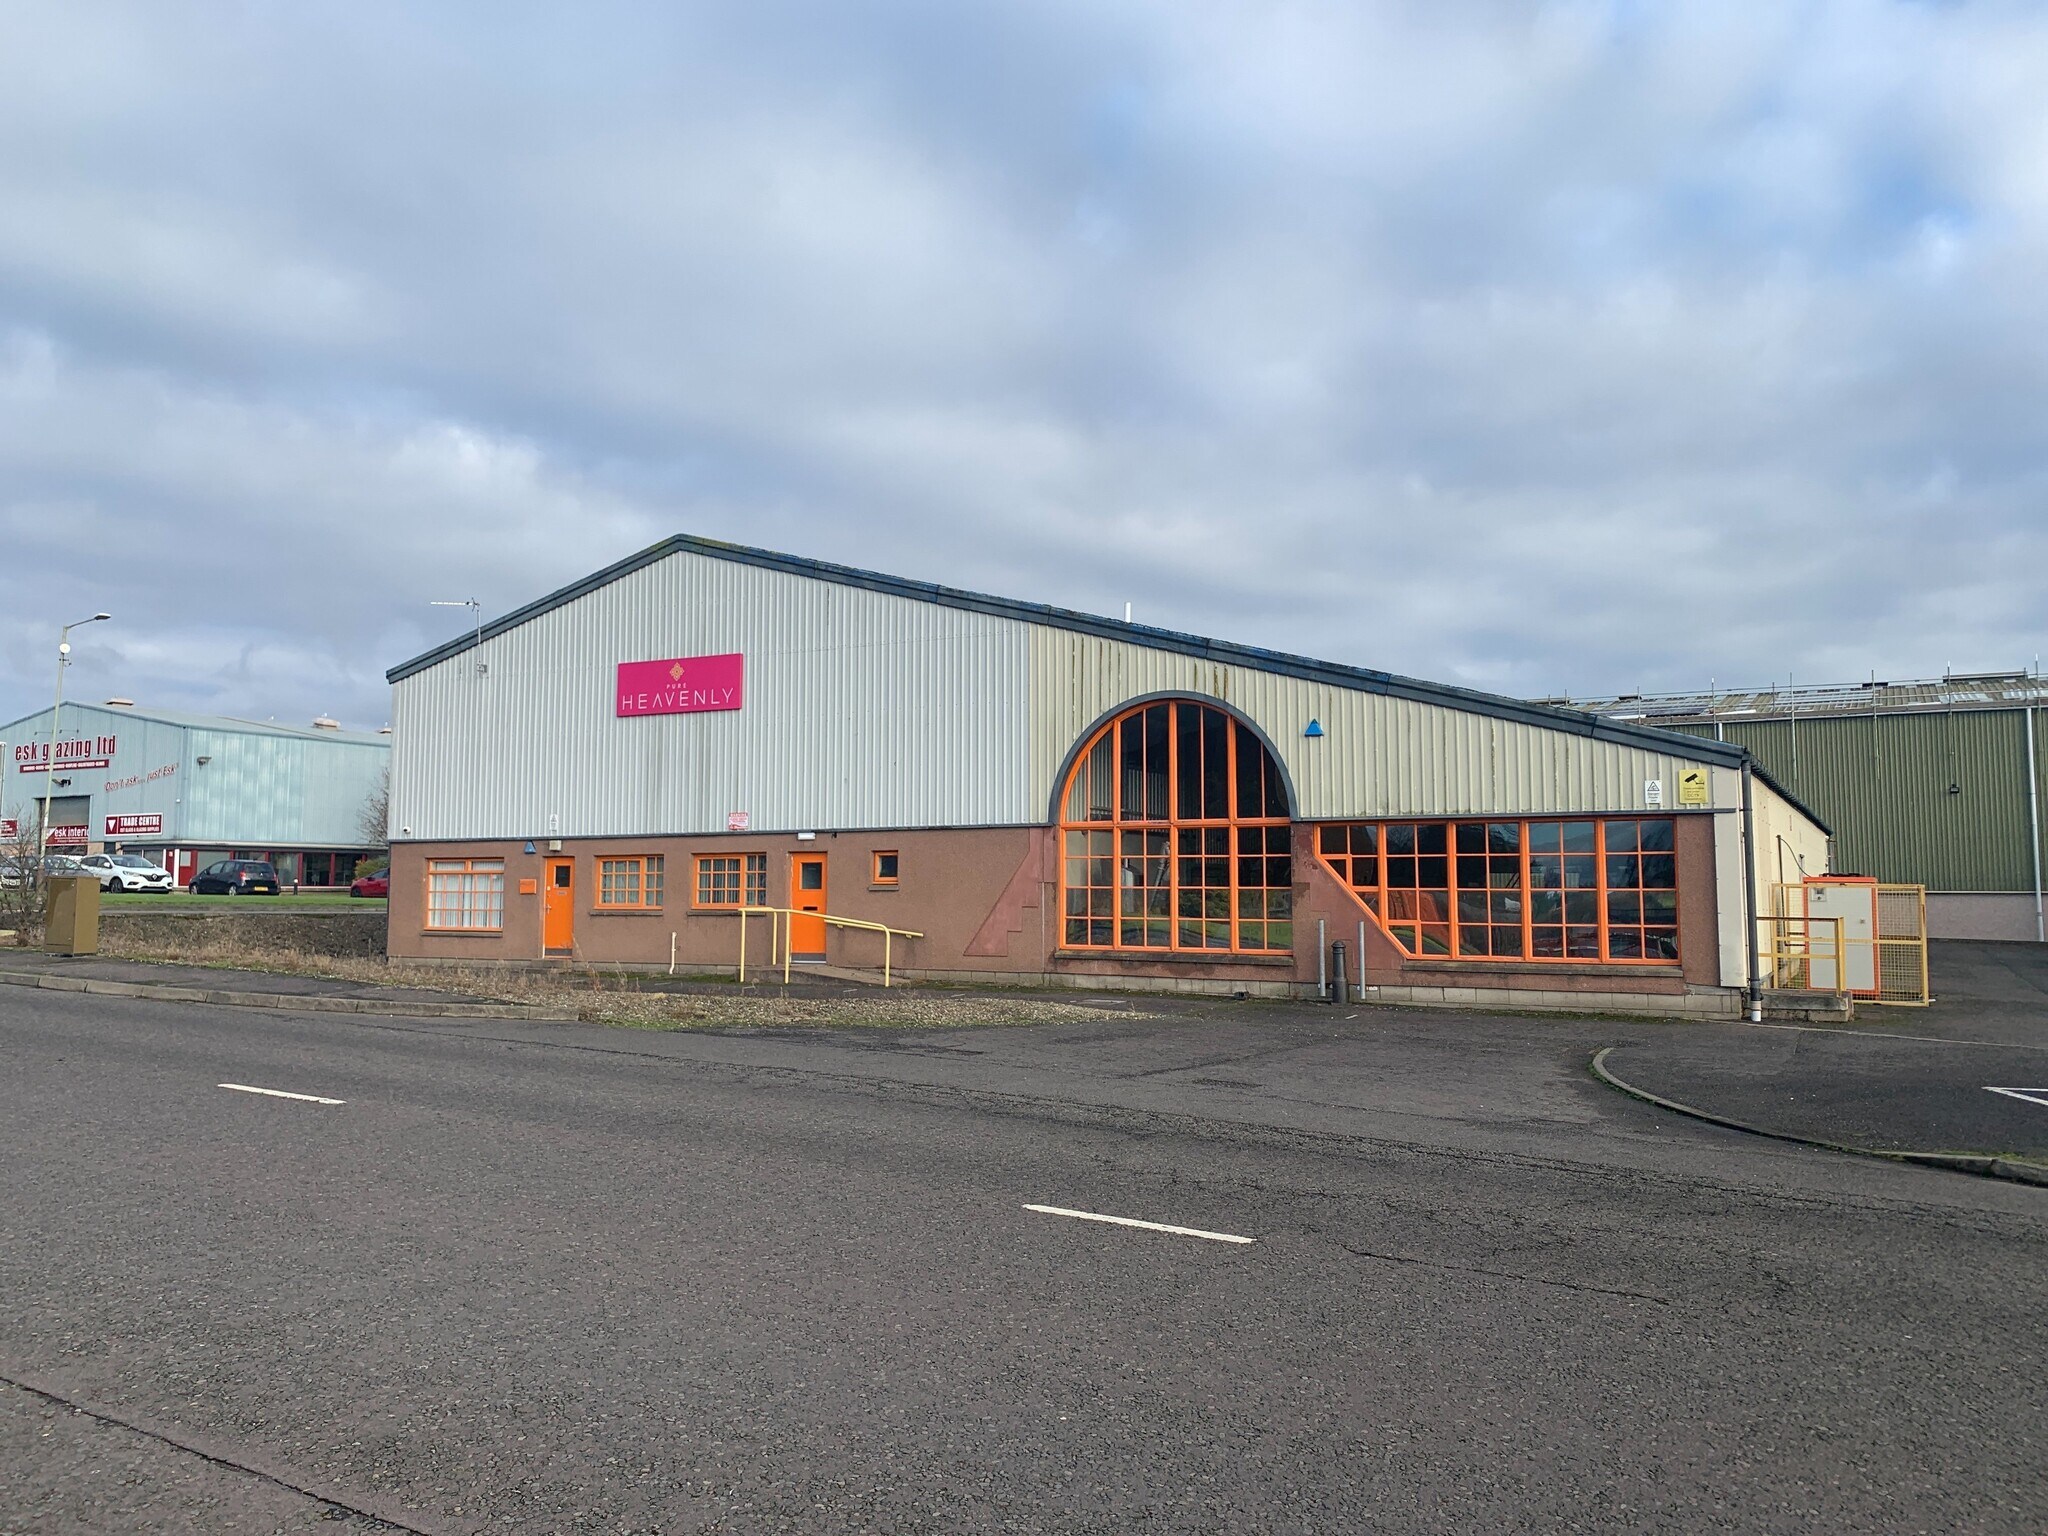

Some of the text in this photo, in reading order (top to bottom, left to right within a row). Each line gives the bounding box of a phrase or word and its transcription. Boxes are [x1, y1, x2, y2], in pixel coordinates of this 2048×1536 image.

[622, 687, 734, 711] HEAVENLY
[15, 735, 116, 761] esk gazing ltd
[120, 815, 160, 827] TRADE CENTRE
[54, 826, 67, 837] esk
